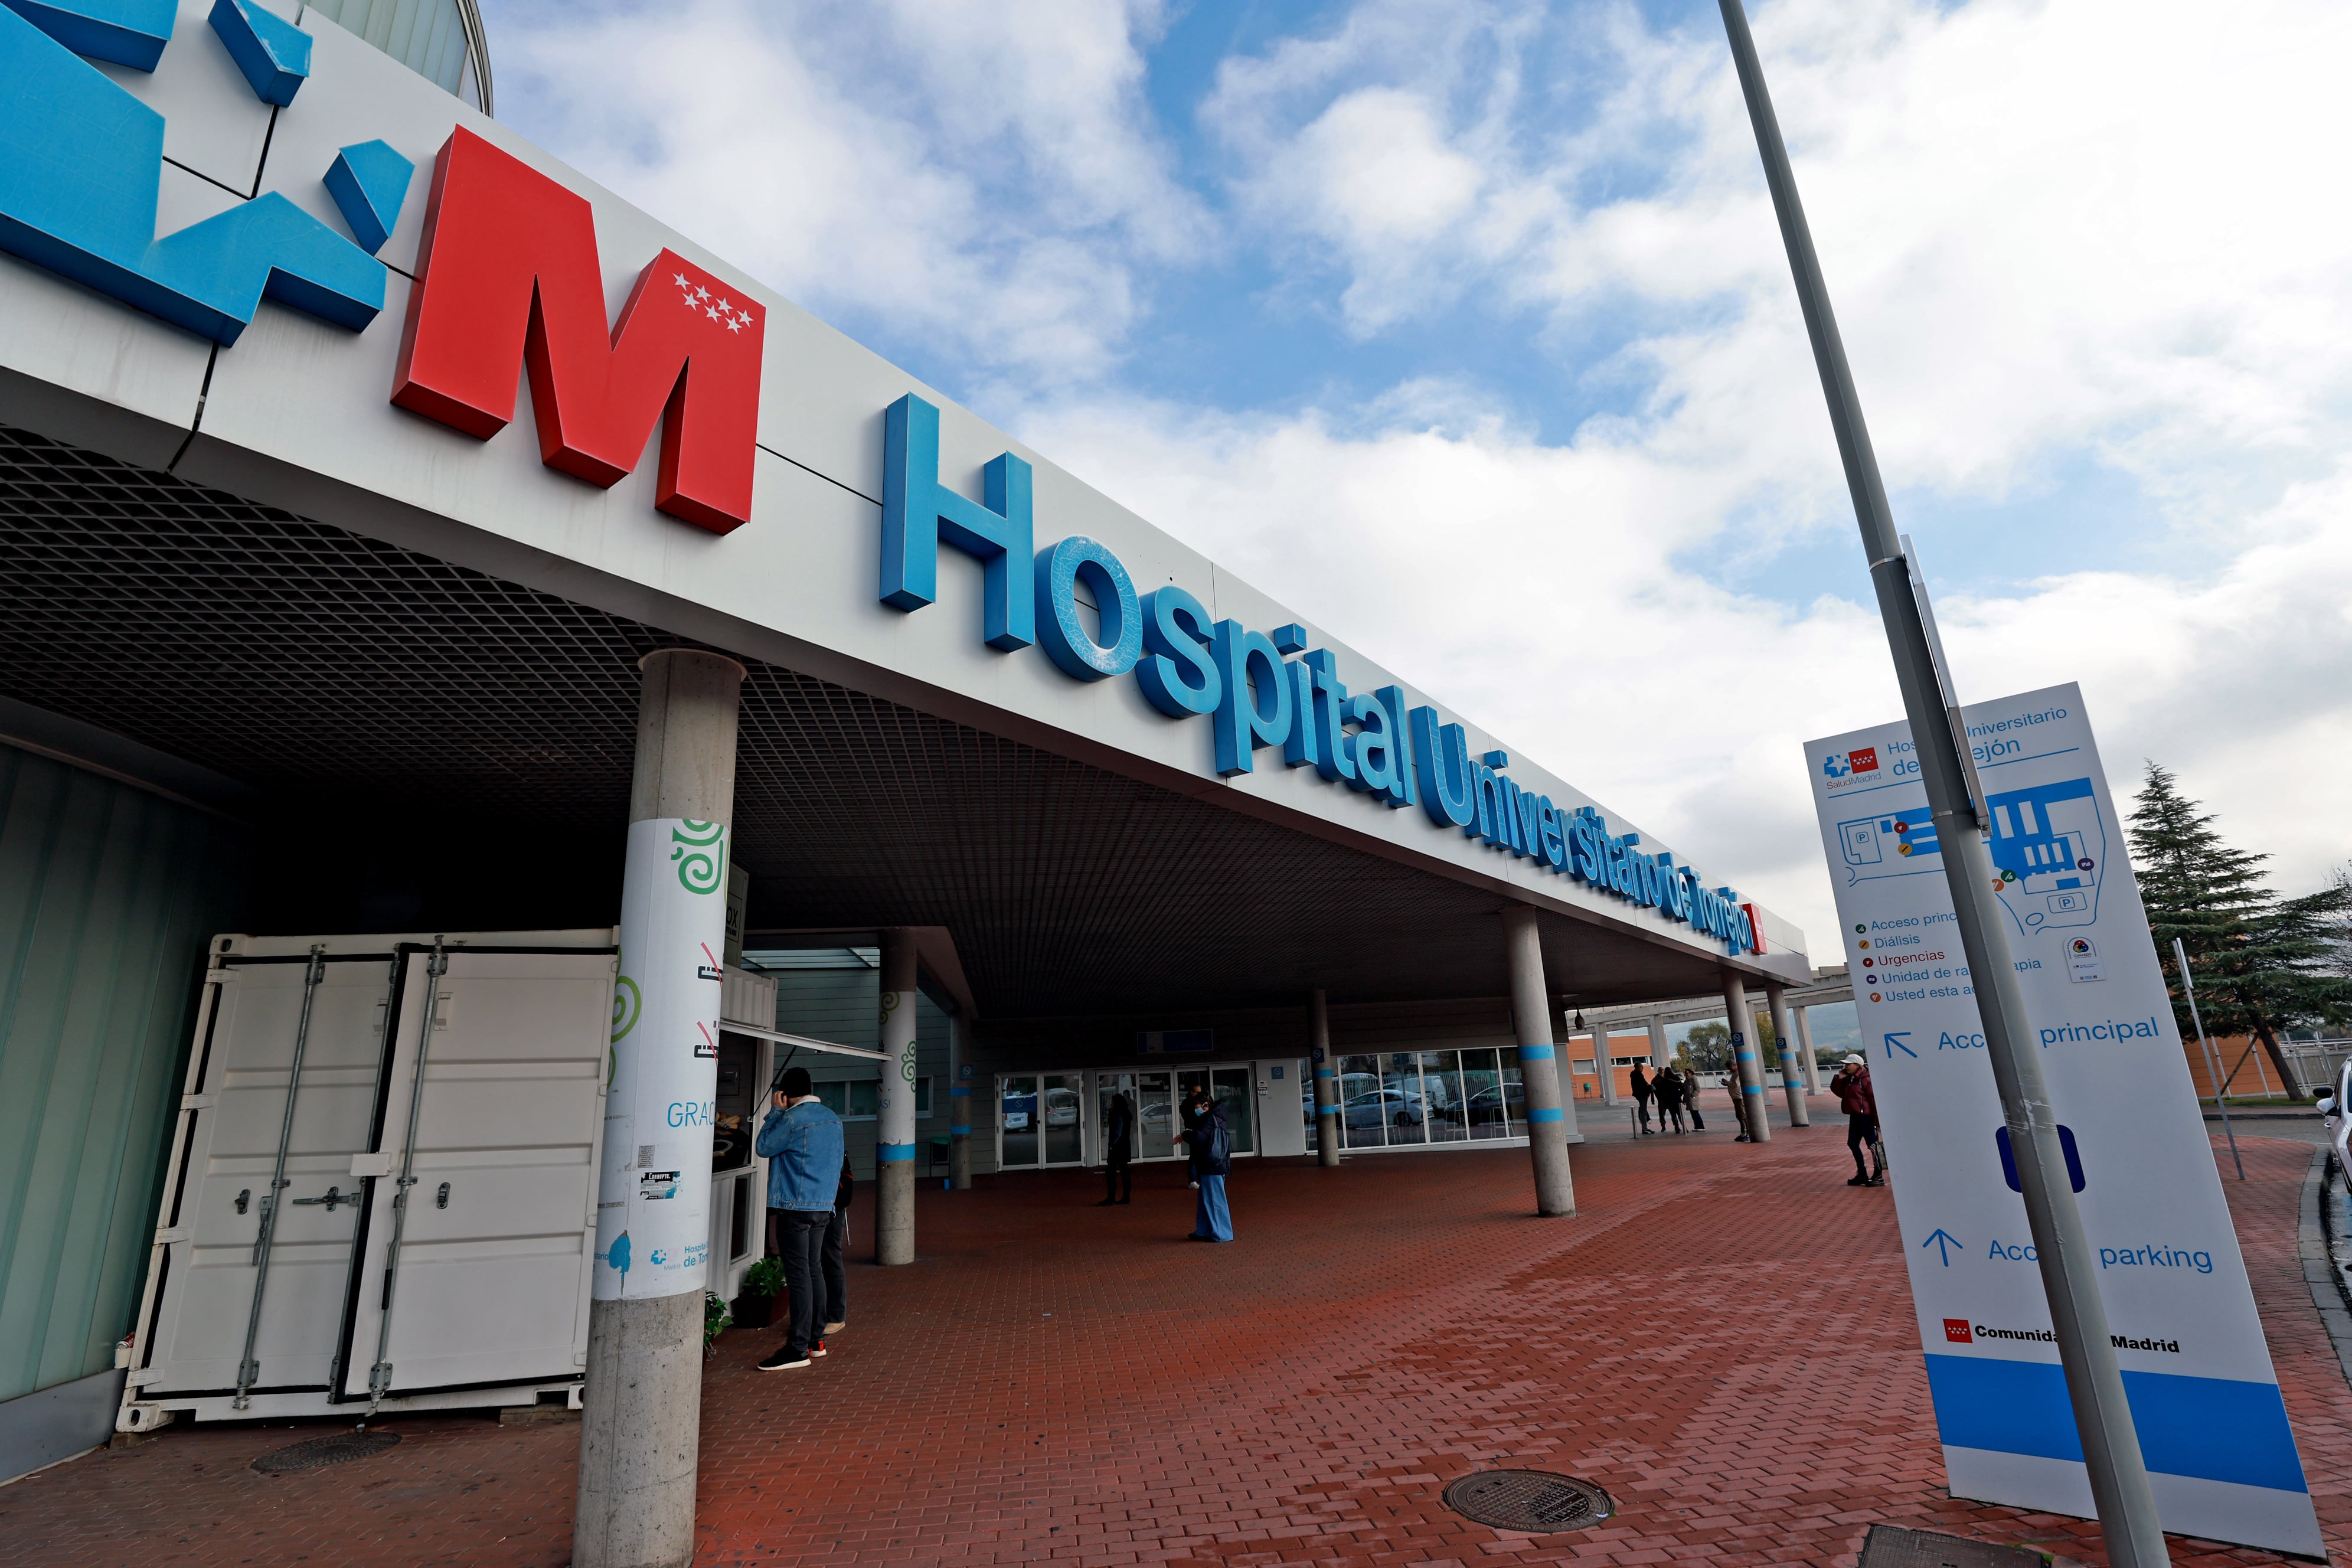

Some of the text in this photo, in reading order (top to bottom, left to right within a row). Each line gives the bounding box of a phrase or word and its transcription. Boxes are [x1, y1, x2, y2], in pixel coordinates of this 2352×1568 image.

[880, 391, 1415, 807] Hospital
[1410, 705, 1662, 907] Universitario
[1658, 852, 1693, 923] de
[1893, 739, 2021, 776] de ejón
[1827, 772, 1881, 790] SaludMadrid
[1871, 912, 1958, 931] Acceso princ
[1874, 934, 1920, 949] Diálisis
[1879, 950, 1945, 967] Urgencias
[1882, 969, 1929, 984] Unidad
[1934, 968, 1951, 978] de
[1886, 987, 1925, 1002] Usted
[1929, 986, 1959, 998] esta
[1938, 1017, 2159, 1050] Acc principal
[684, 1256, 696, 1268] de
[1989, 1240, 2213, 1274] Acc parking
[1975, 1325, 2180, 1353] Comunid Madrid
